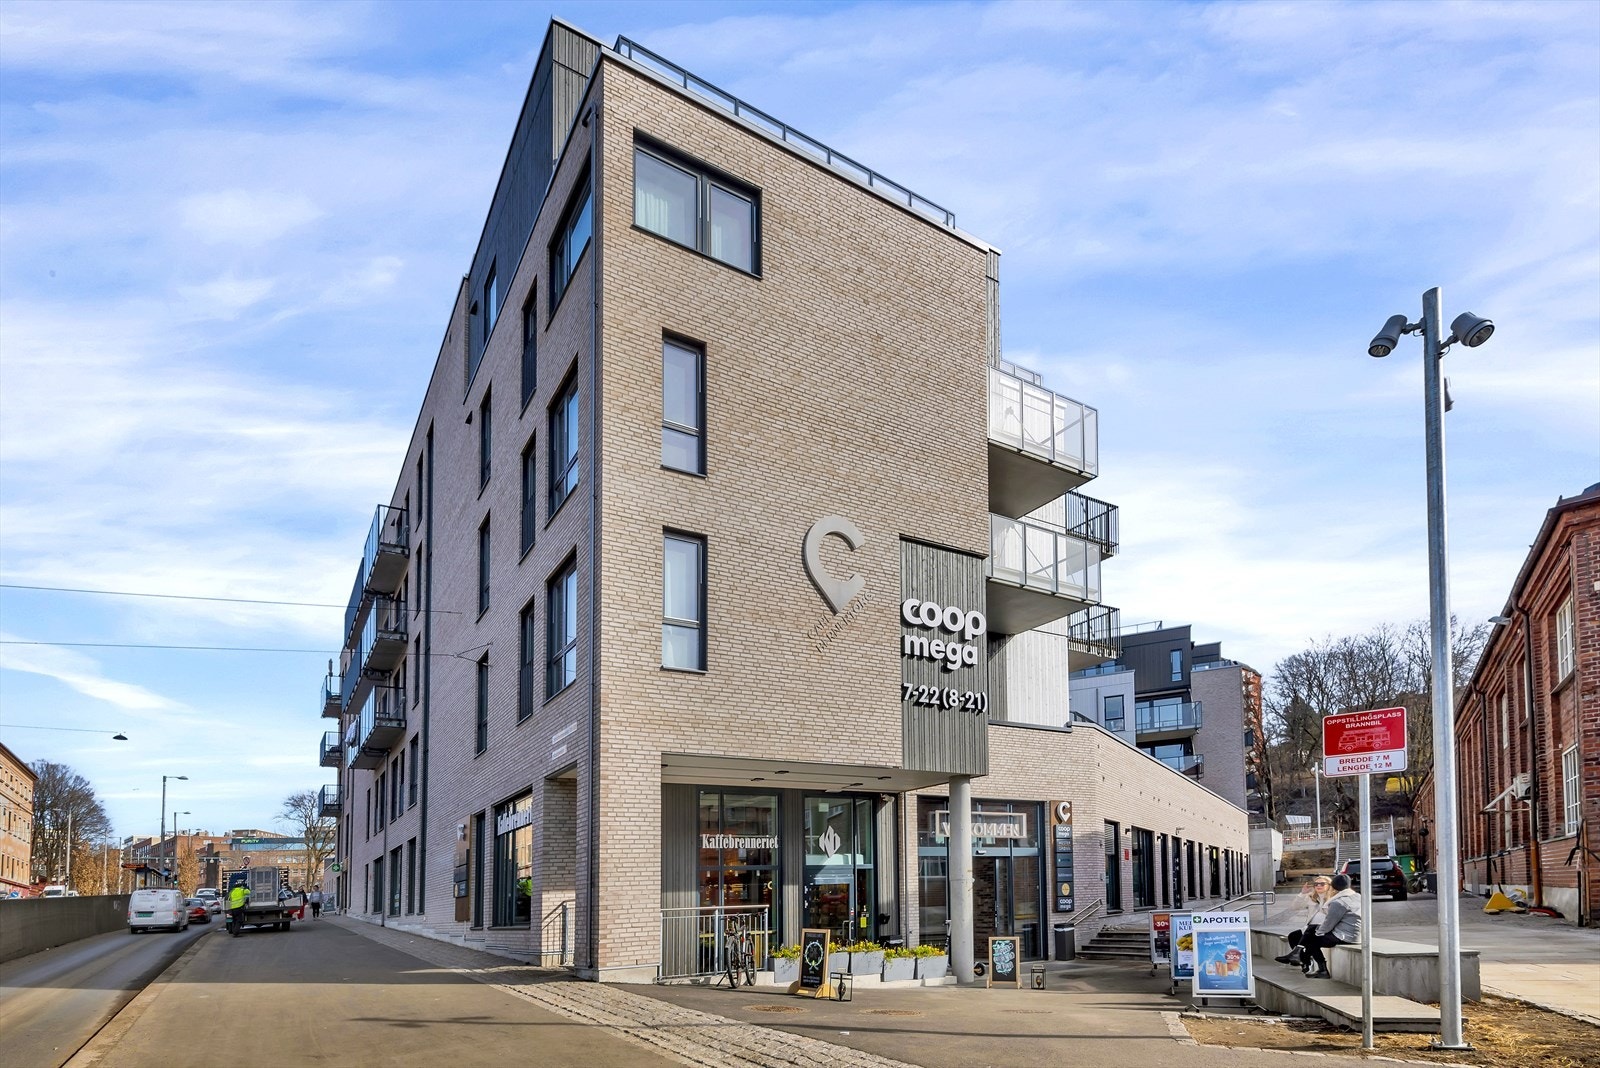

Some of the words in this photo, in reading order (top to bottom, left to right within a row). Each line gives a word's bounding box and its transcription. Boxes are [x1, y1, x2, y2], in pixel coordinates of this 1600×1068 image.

[902, 598, 987, 641] coop
[904, 634, 978, 670] mega
[903, 683, 940, 705] 7-22
[943, 686, 988, 713] (8-21)
[1326, 712, 1402, 725] OPPSTILLINGSPLASS
[1340, 756, 1373, 764] BREDDE
[941, 822, 1020, 836] VOMMEN
[702, 833, 779, 849] Kaffebrenneriet
